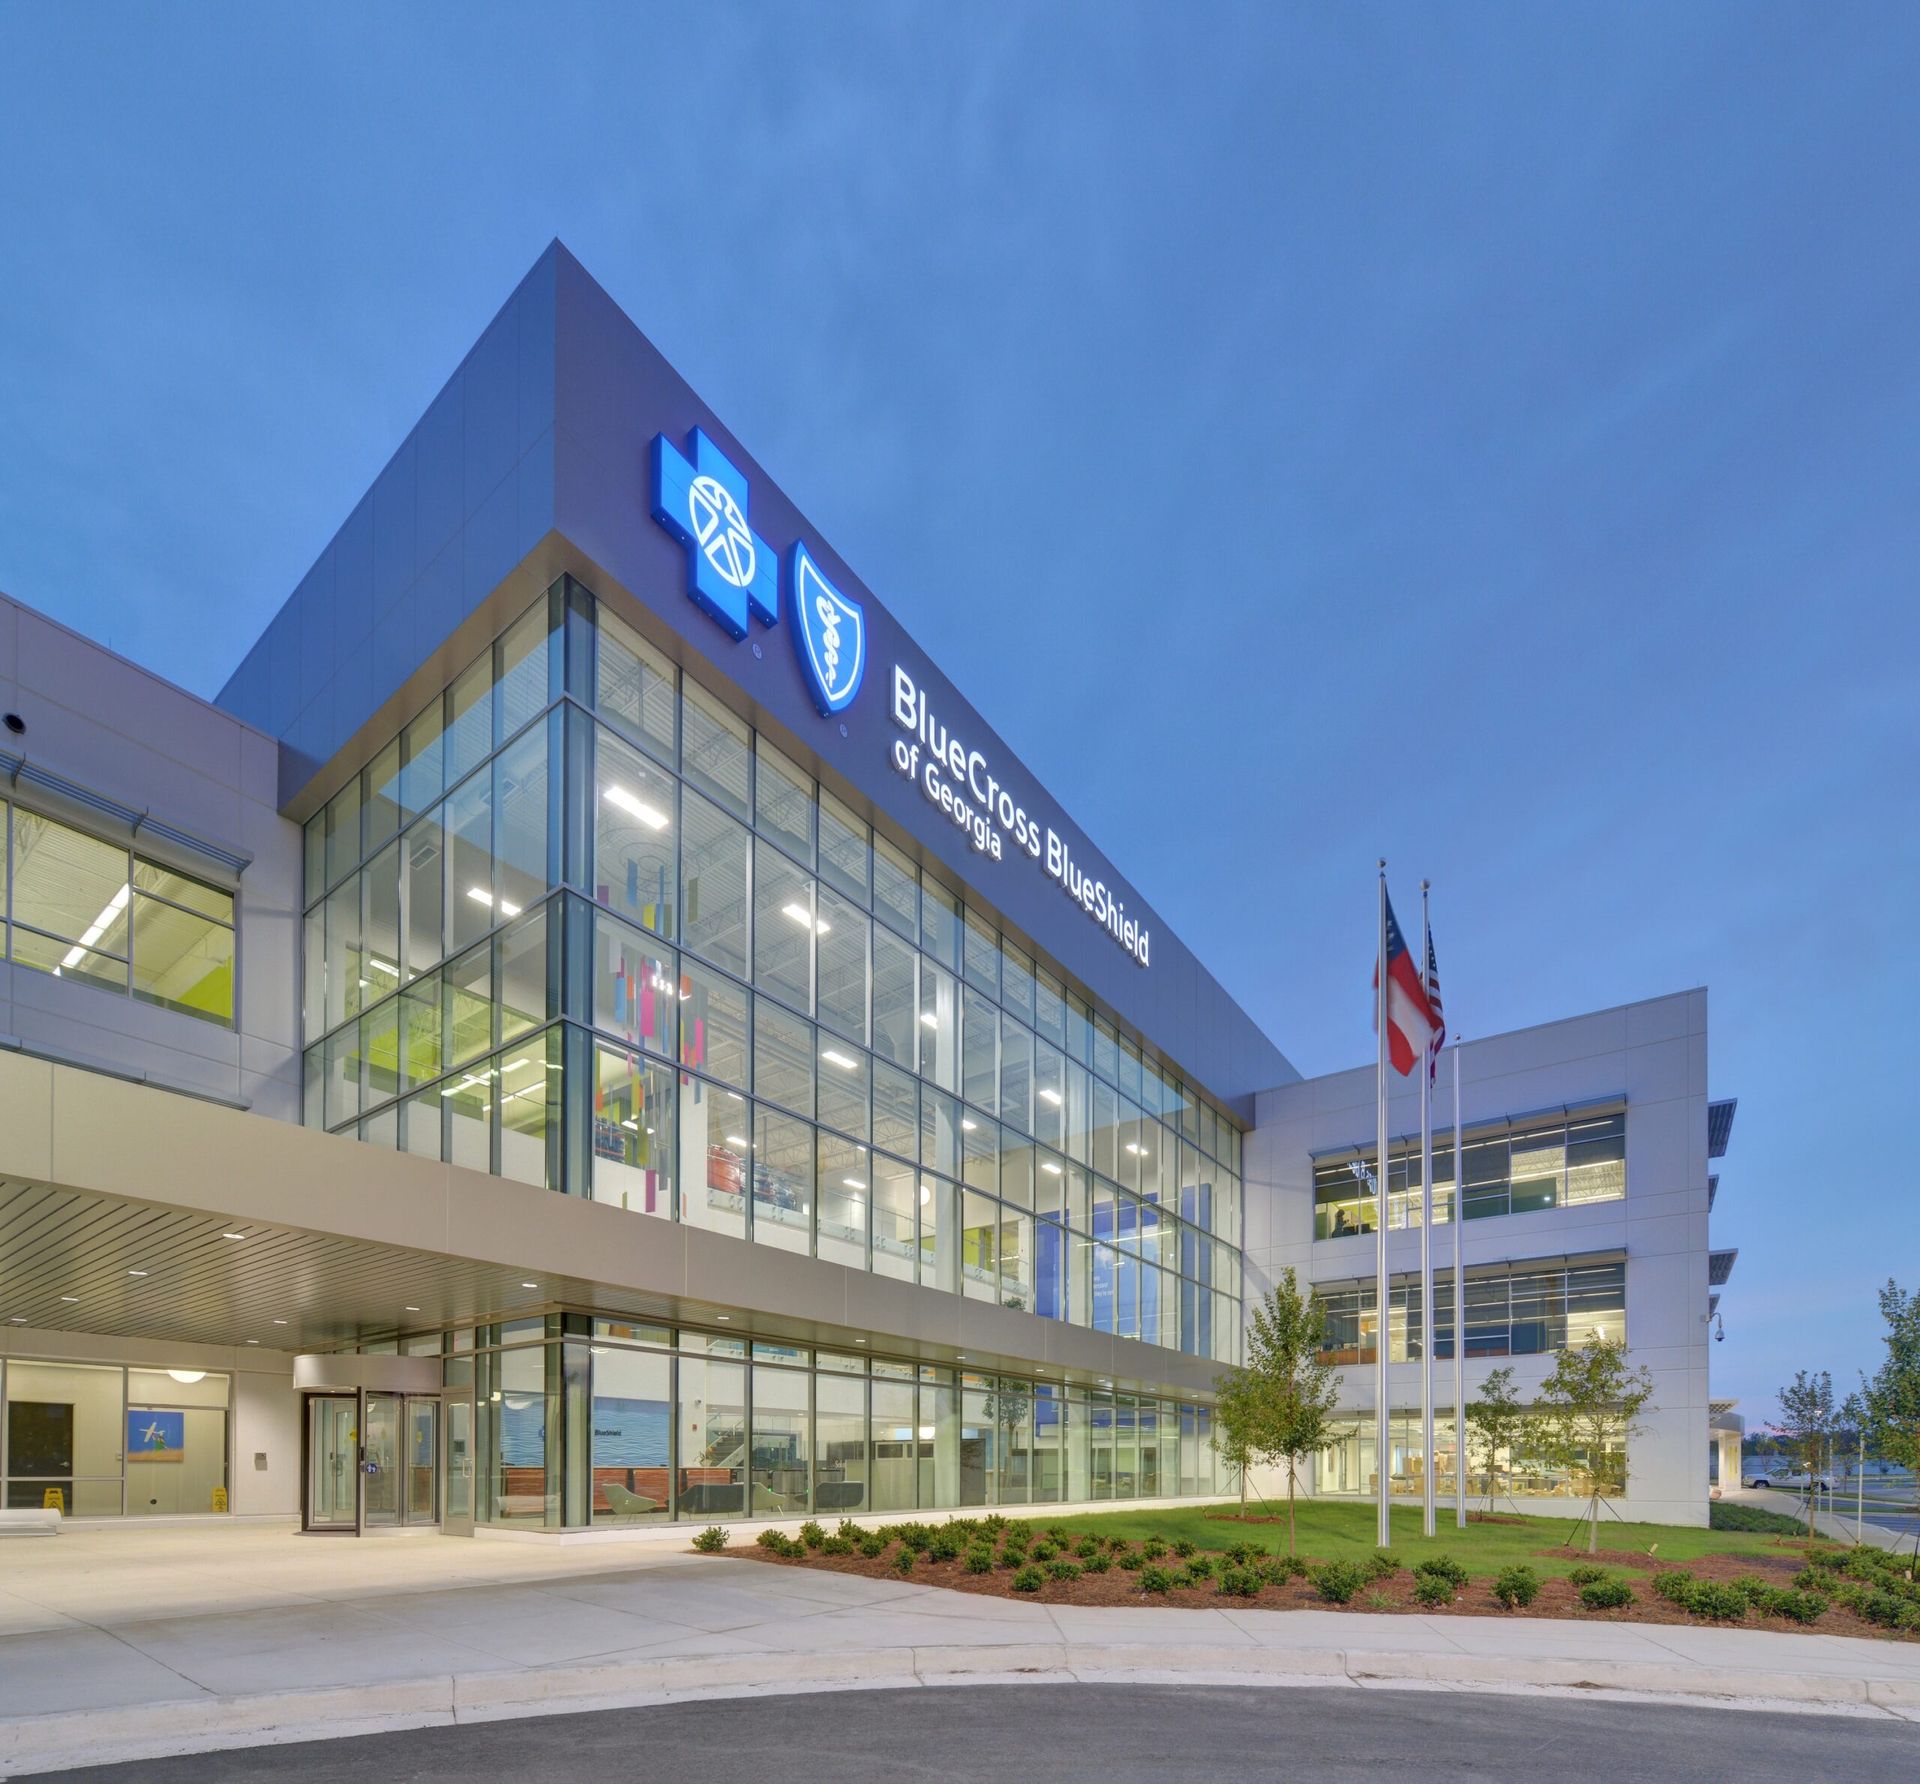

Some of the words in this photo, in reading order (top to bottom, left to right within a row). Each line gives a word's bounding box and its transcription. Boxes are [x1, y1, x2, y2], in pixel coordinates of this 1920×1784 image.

[893, 664, 1042, 858] BlueCross
[1045, 827, 1151, 968] BlueShield
[894, 739, 920, 781] of
[922, 762, 1003, 862] Georgia
